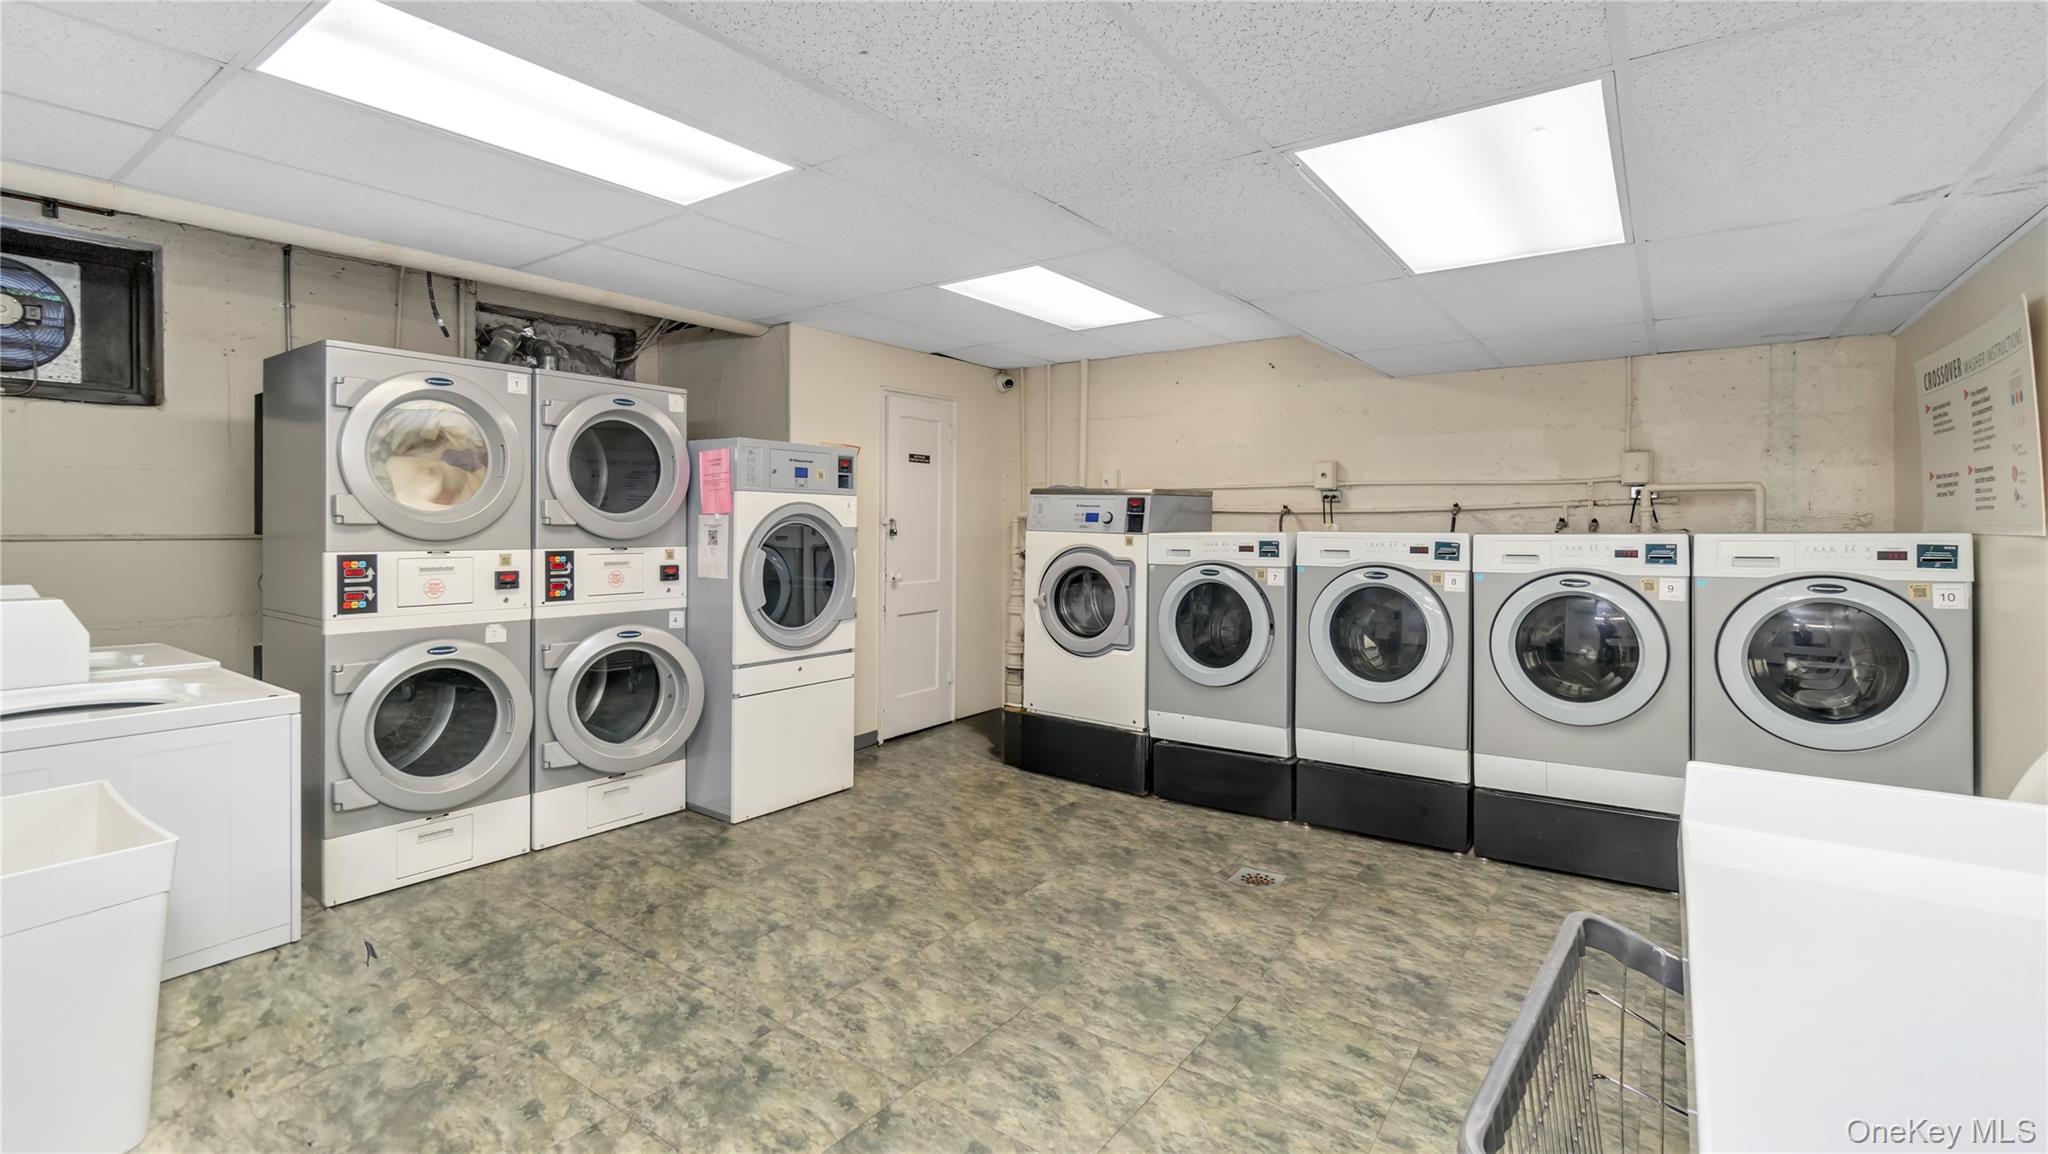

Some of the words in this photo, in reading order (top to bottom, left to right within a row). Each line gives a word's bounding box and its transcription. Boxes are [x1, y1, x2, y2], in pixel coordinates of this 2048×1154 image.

[1923, 357, 1962, 391] CROSSOVER
[1963, 351, 1986, 374] WASHER
[1987, 328, 2023, 362] INSTRUCTIONS
[1667, 584, 1674, 594] 9
[1940, 592, 1956, 602] 10
